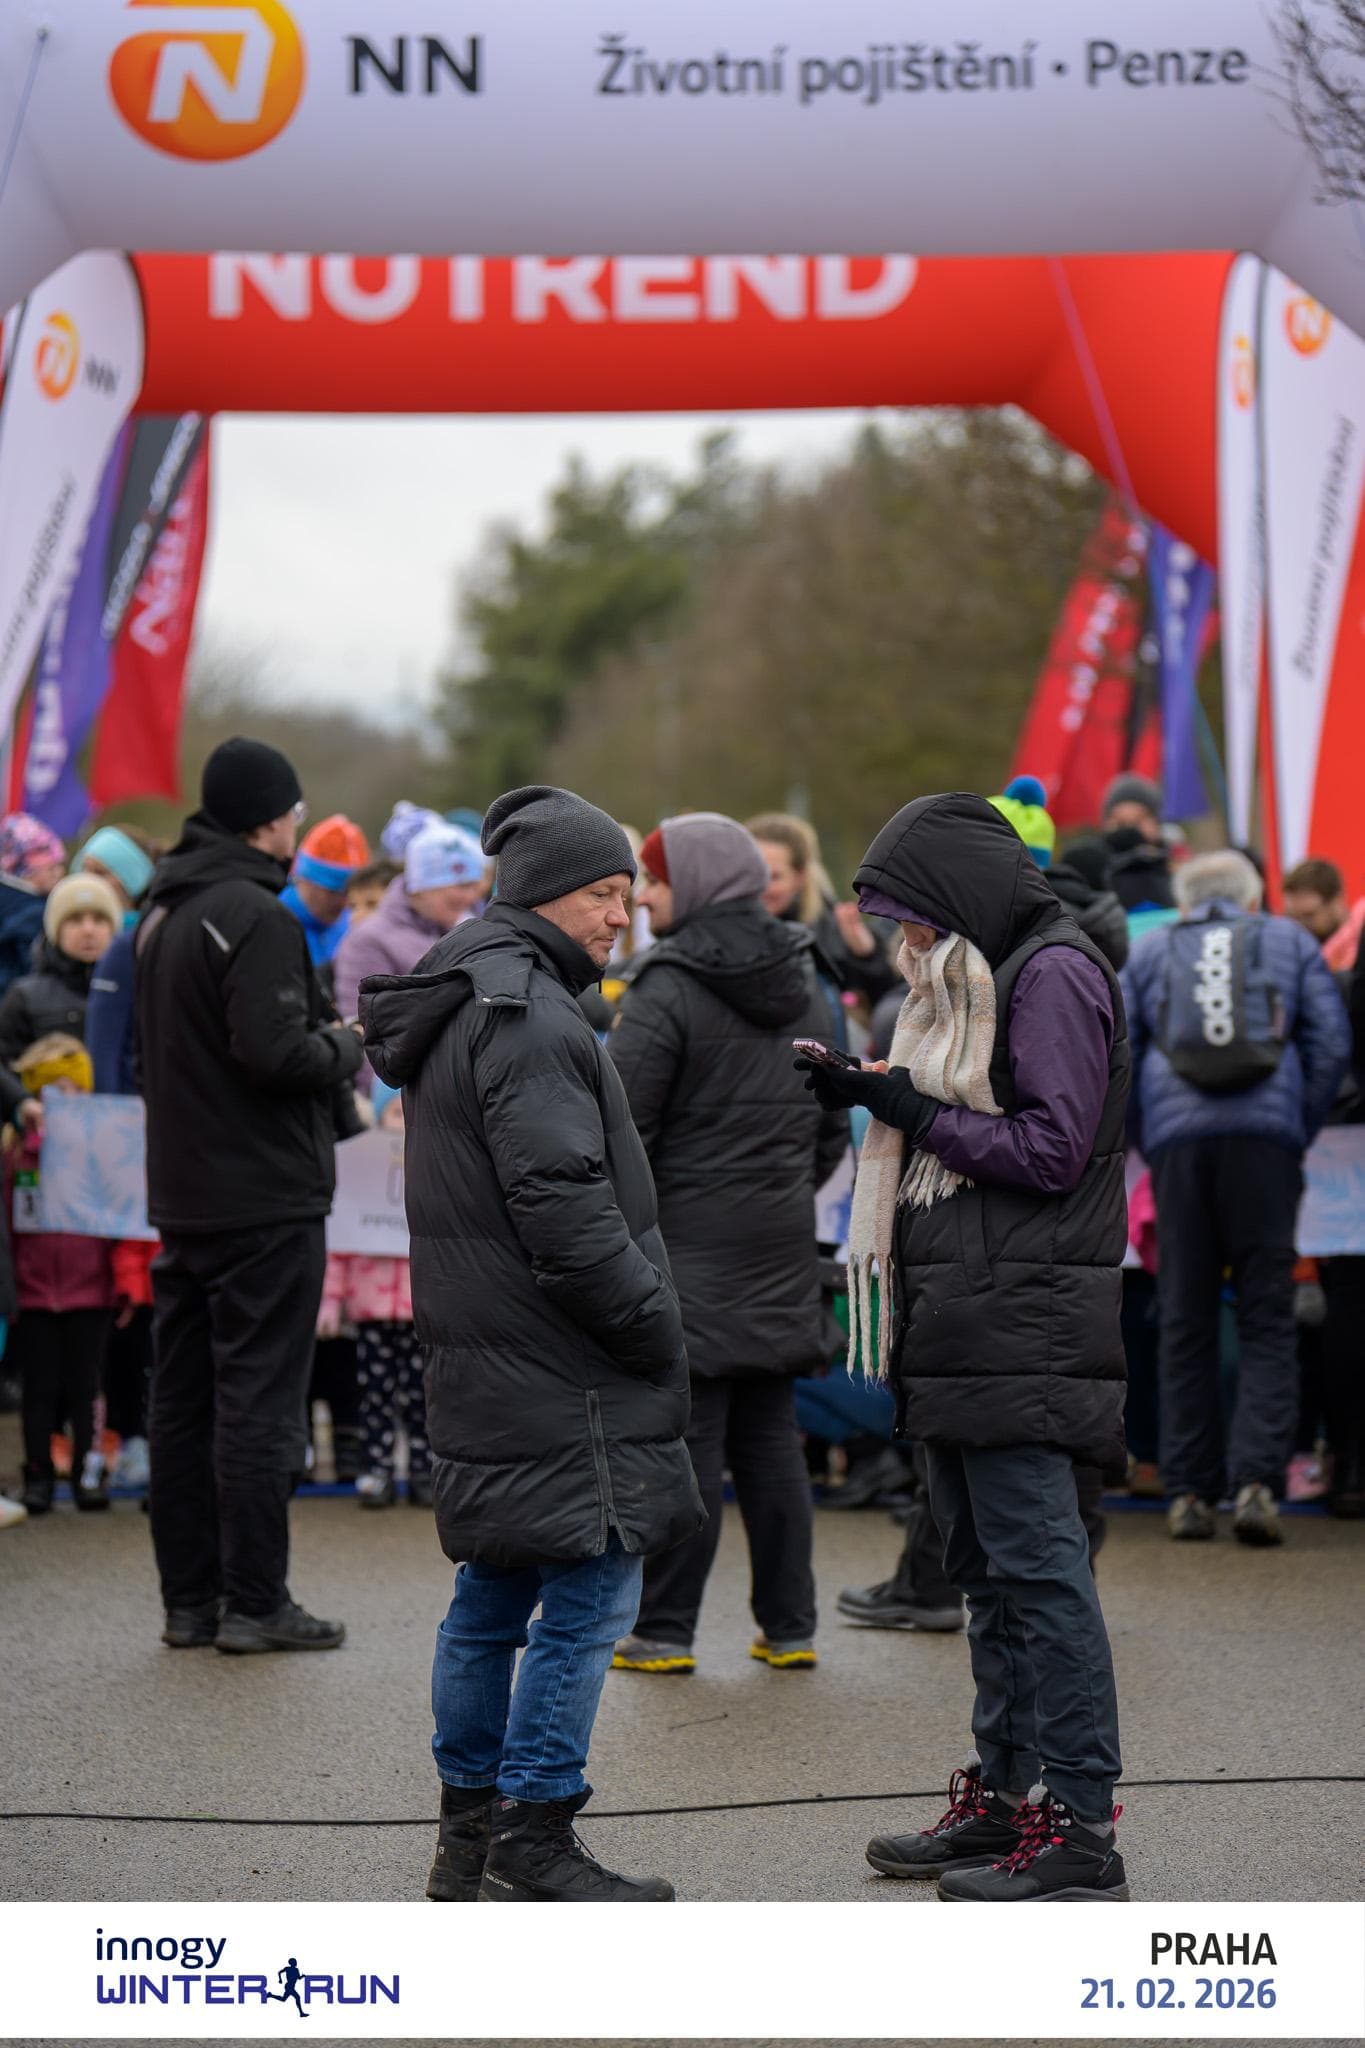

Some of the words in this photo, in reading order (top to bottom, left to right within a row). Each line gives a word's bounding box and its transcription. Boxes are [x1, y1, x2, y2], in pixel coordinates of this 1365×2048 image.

[347, 35, 484, 94] NN
[597, 35, 788, 95] Životní
[800, 43, 1036, 104] pojištění
[1086, 39, 1249, 87] Penze
[1193, 926, 1234, 1047] adidas
